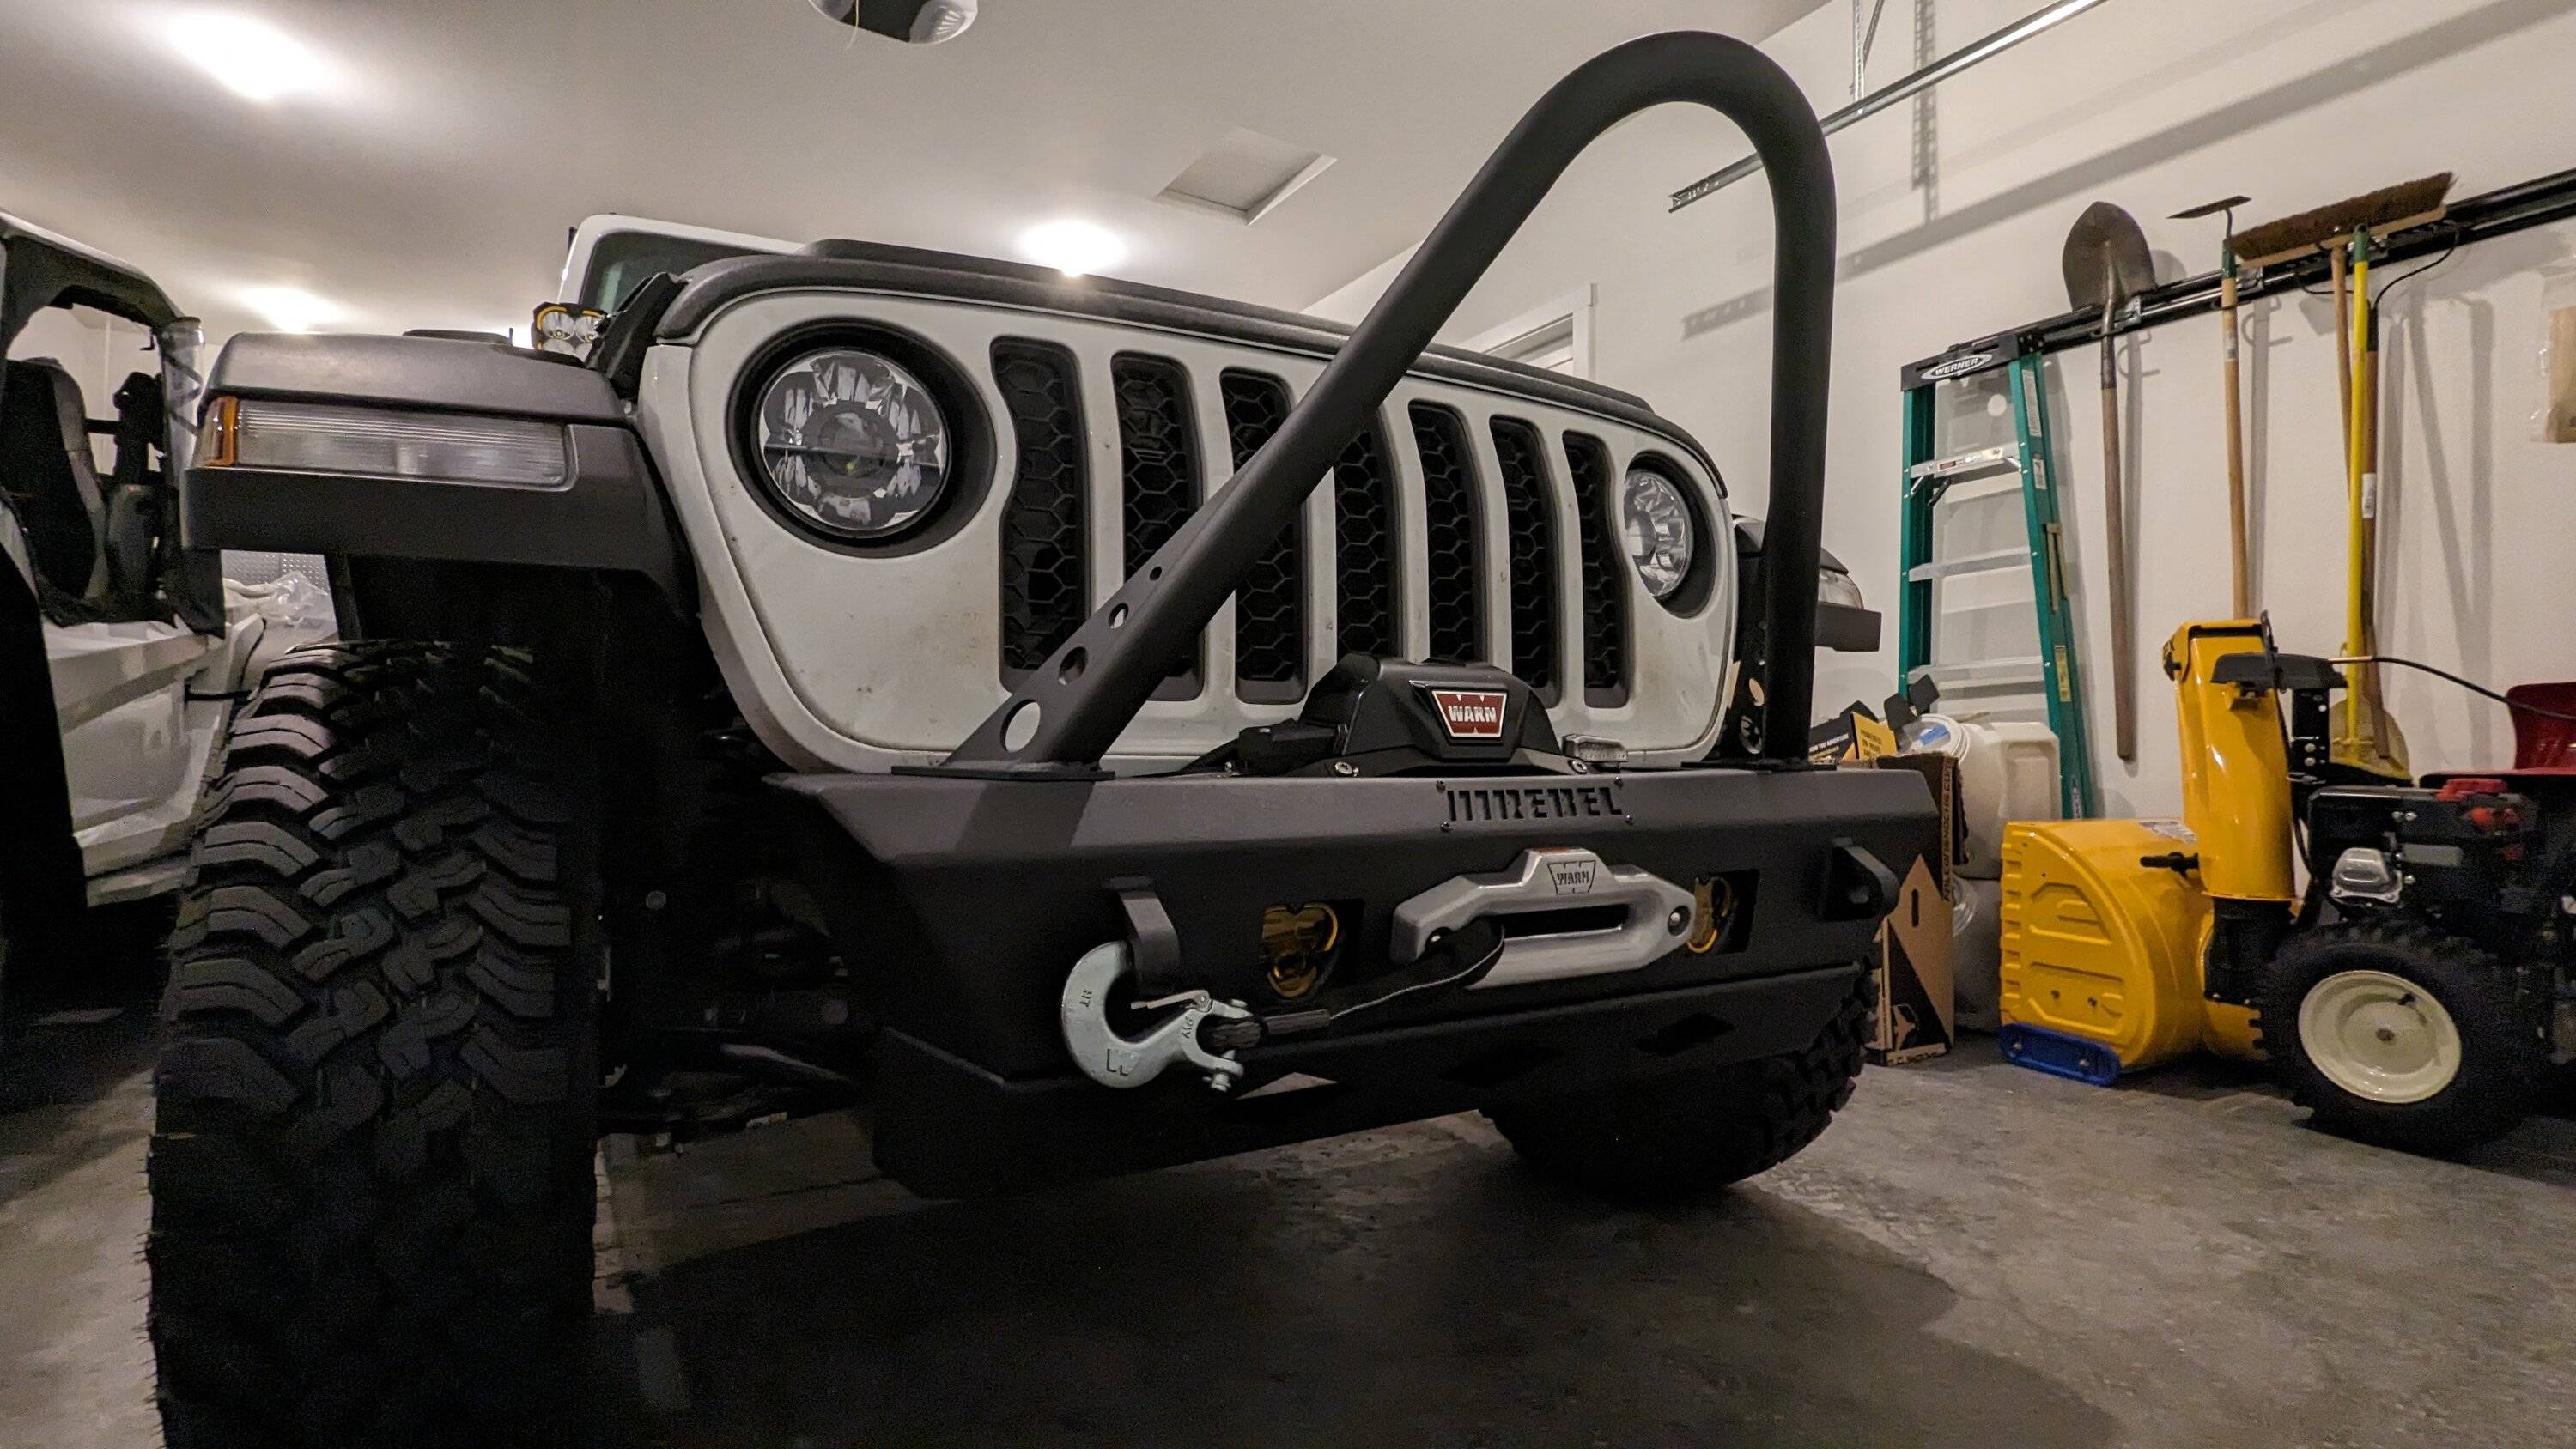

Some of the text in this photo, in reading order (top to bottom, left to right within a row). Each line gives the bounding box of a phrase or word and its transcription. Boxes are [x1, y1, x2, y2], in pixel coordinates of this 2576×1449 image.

[1935, 358, 1978, 375] WERNER
[1448, 705, 1496, 723] WARN
[1557, 870, 1589, 885] WARN
